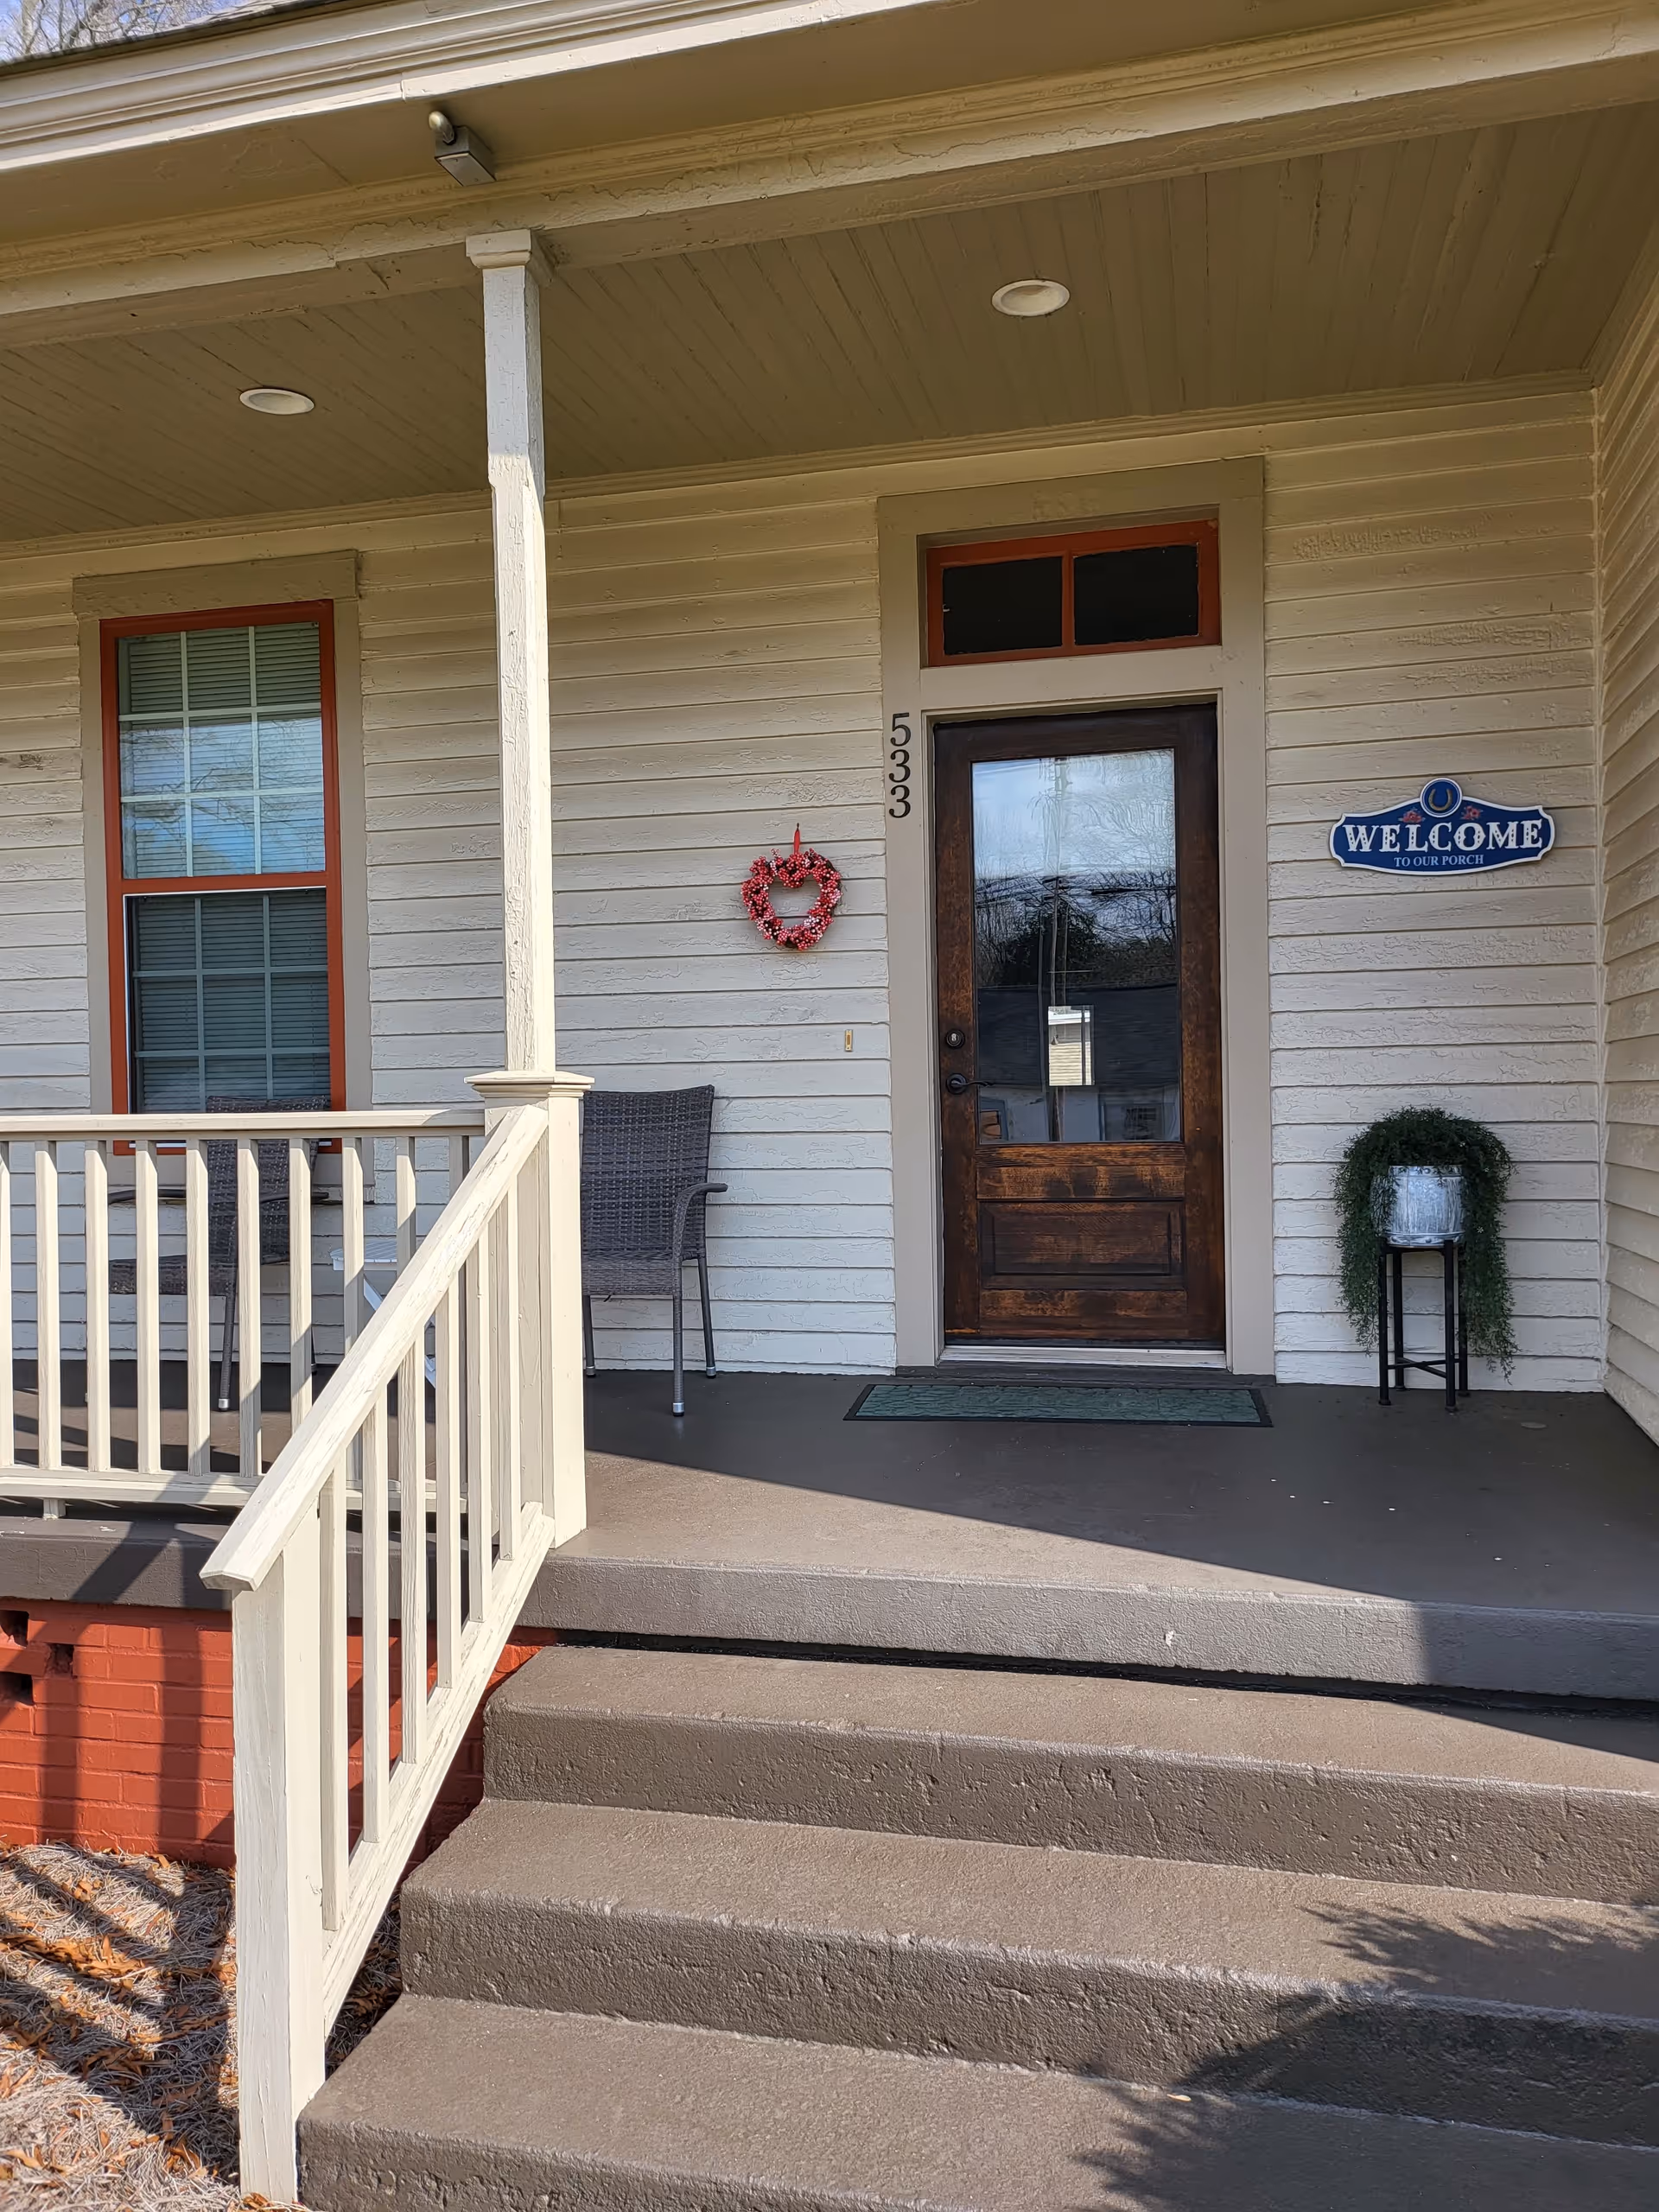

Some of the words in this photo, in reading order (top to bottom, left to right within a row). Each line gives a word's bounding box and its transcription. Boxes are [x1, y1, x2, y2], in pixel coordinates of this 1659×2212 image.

[888, 712, 912, 818] 533
[1342, 819, 1543, 853] WELCOME
[1394, 856, 1410, 868] TO
[1413, 855, 1440, 867] OUR
[1442, 854, 1484, 866] PORCH
